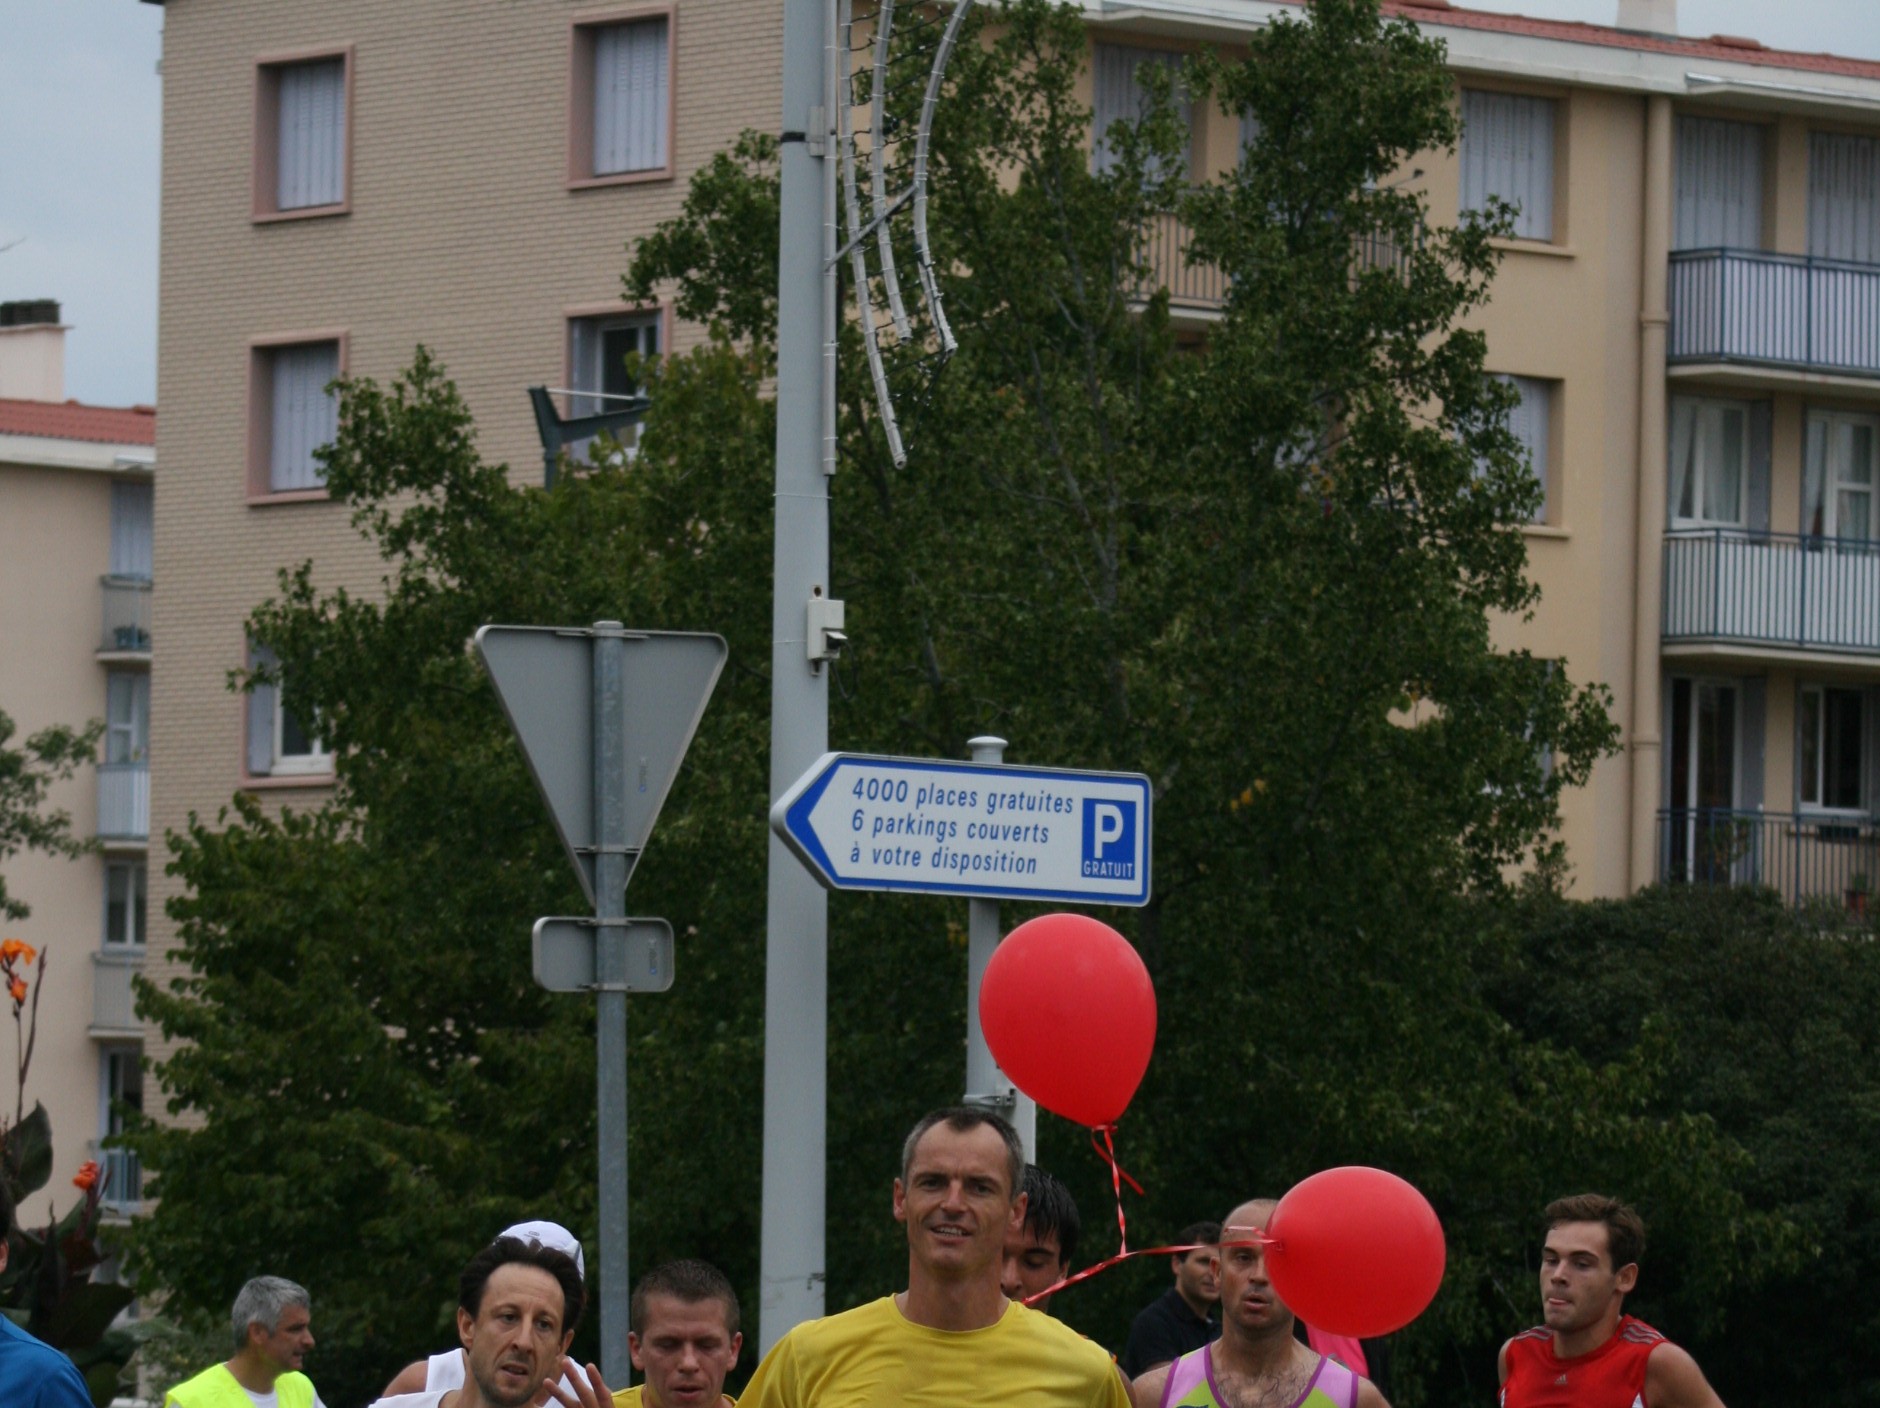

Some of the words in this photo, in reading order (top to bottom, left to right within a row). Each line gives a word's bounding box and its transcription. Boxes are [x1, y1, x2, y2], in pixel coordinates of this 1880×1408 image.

[852, 778, 908, 803] 4000
[916, 782, 978, 810] places
[987, 788, 1074, 815] gratuites
[852, 809, 864, 832] 6
[872, 812, 958, 842] parkings
[967, 823, 1050, 844] couverts
[1094, 803, 1124, 860] P
[850, 841, 860, 864] à
[872, 846, 922, 868] votre
[931, 848, 1038, 876] disposition
[1083, 860, 1134, 879] GRATUIT
